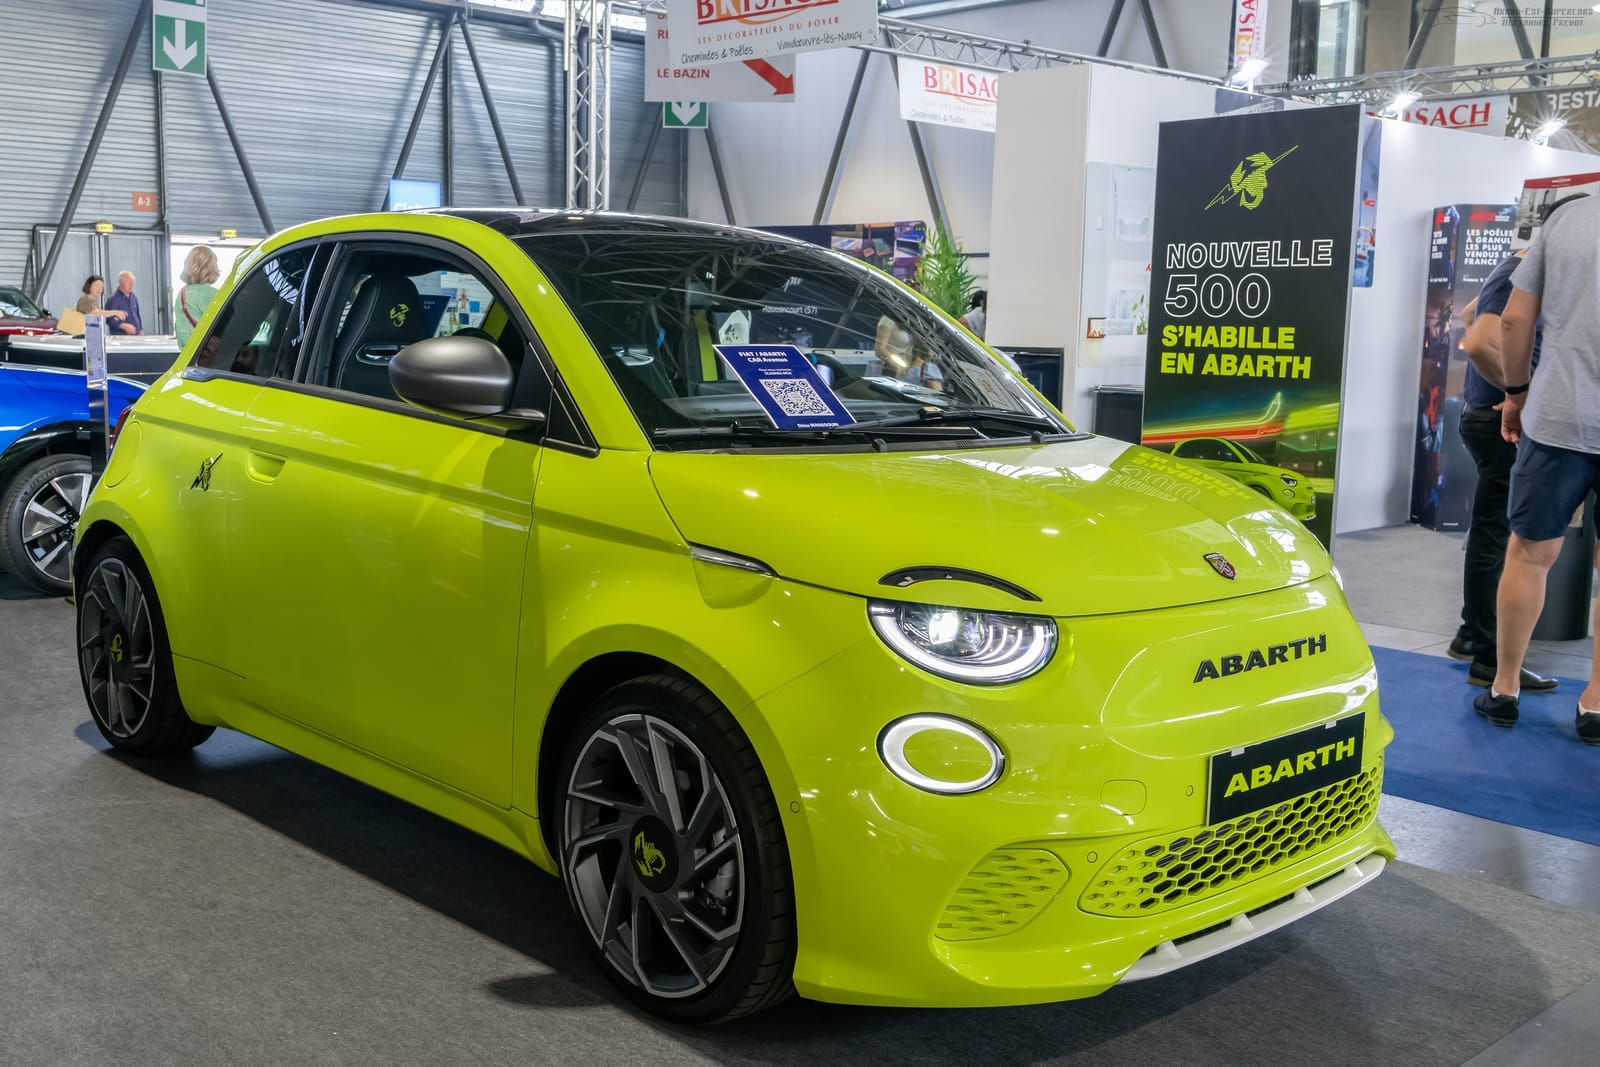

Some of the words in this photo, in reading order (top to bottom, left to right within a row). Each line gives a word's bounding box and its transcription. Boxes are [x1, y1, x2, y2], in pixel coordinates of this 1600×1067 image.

[789, 22, 803, 31] DU
[807, 16, 840, 28] FOYER
[1236, 0, 1256, 65] RISA
[657, 68, 670, 79] LE
[673, 68, 711, 79] BAZIN
[923, 65, 999, 99] BRISAC
[1404, 102, 1491, 126] SACH
[1165, 239, 1335, 269] NOUVELLE
[1163, 273, 1272, 319] 500
[1161, 324, 1296, 350] S'HABILLE
[1160, 353, 1194, 375] EN
[1200, 354, 1312, 379] ABARTH
[1193, 632, 1328, 684] ABARTH
[1223, 736, 1356, 798] ABARTH
